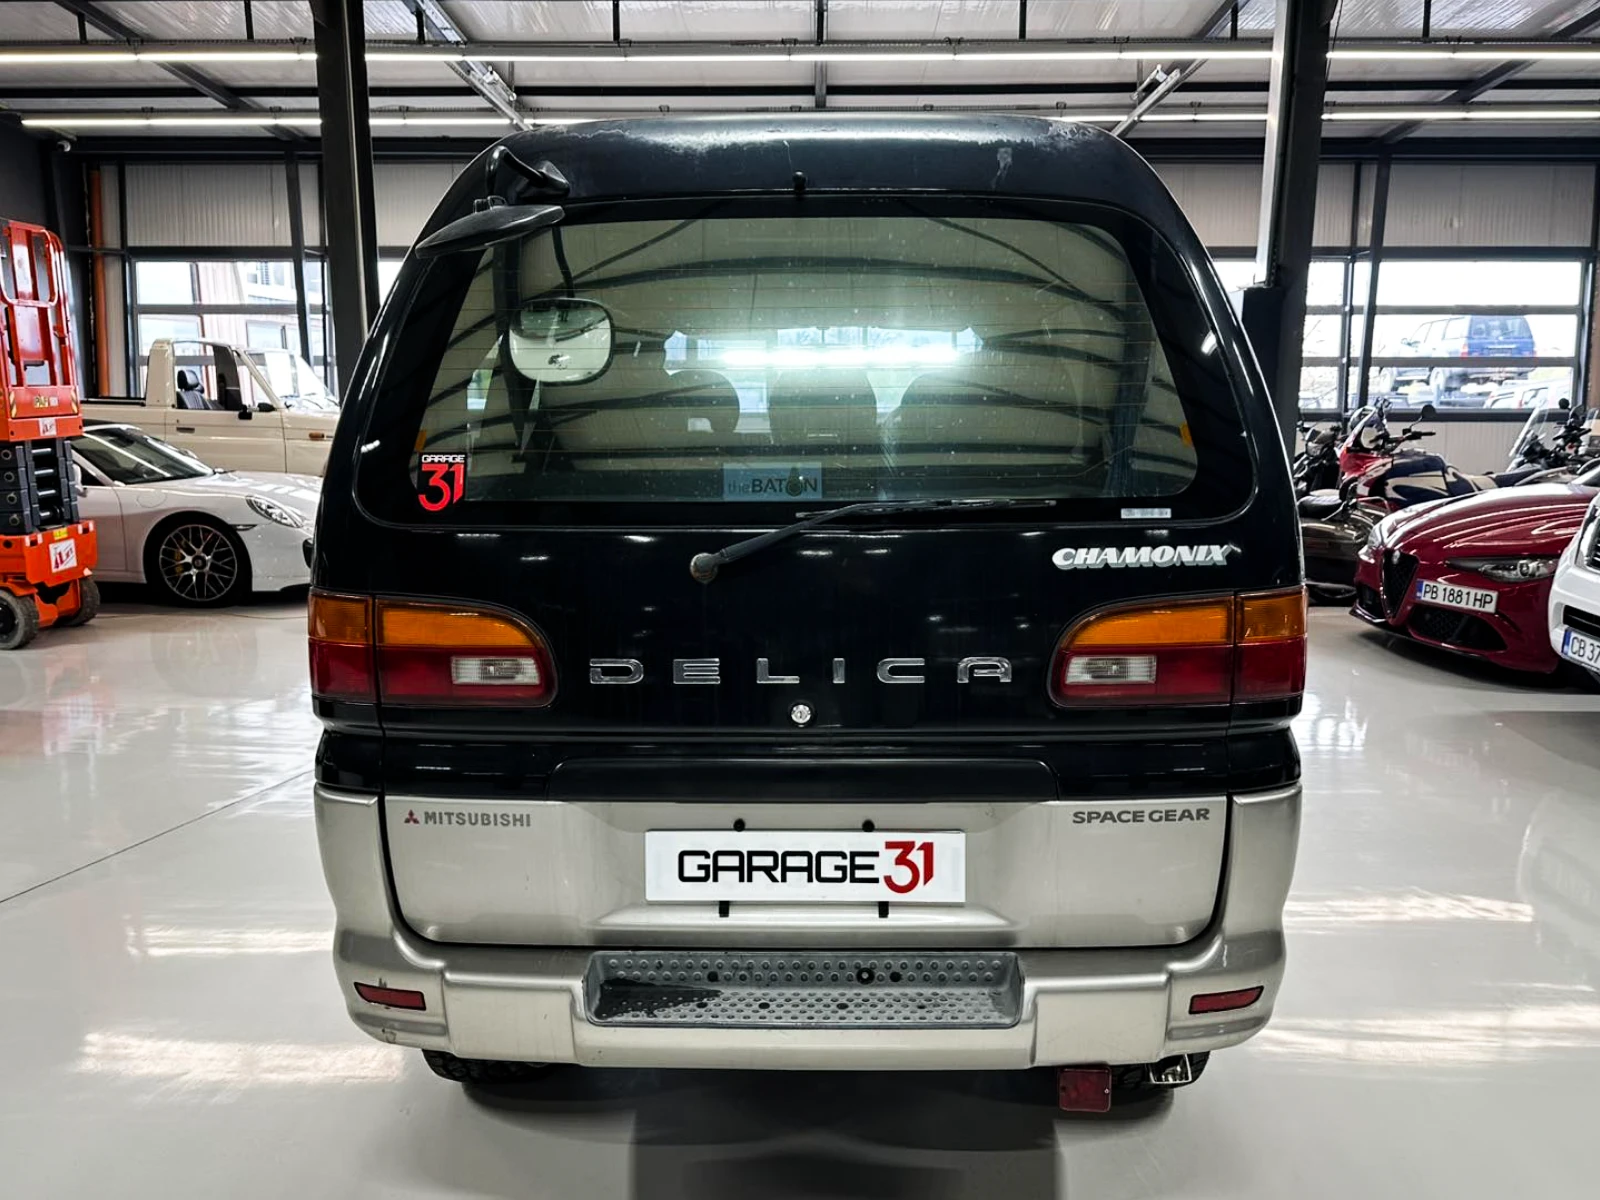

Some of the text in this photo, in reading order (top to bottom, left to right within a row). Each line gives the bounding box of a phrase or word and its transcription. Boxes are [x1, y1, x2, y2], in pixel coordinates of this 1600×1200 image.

[422, 454, 465, 463] GARAGE
[418, 463, 464, 511] 31
[1052, 544, 1228, 570] CHAMONIX
[1423, 584, 1494, 609] PB 1881 HP
[1570, 636, 1586, 657] CB
[589, 656, 1012, 685] DELICA
[424, 811, 531, 827] MITSUBISHI
[1072, 807, 1210, 824] SPACE GEAR
